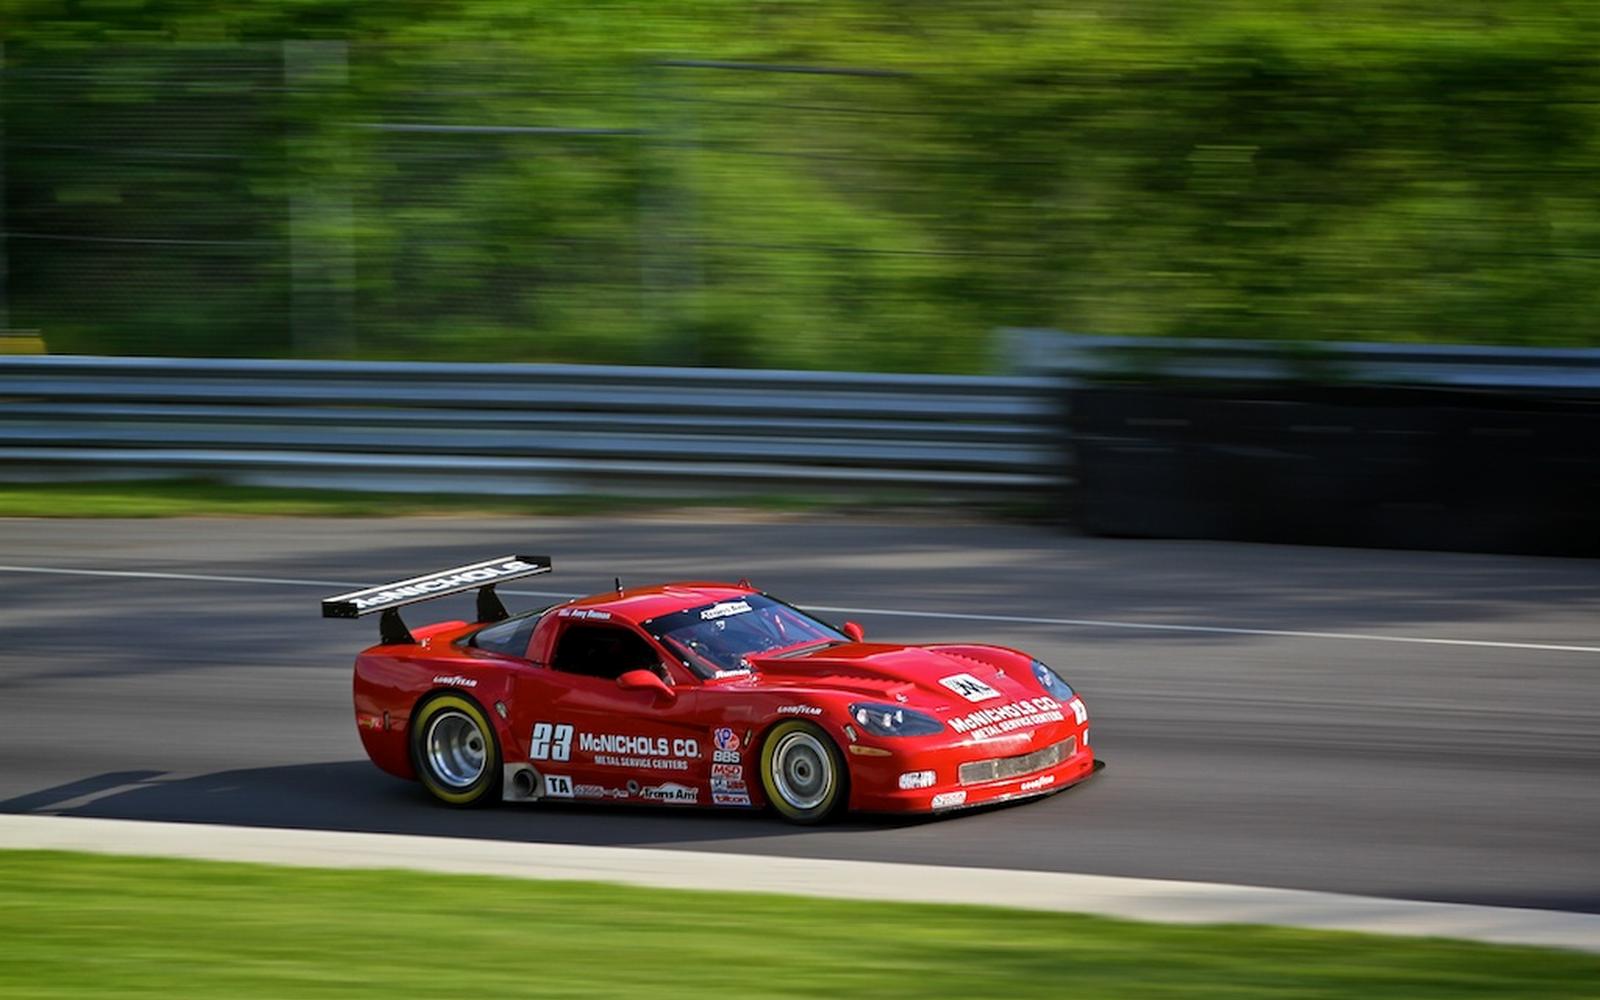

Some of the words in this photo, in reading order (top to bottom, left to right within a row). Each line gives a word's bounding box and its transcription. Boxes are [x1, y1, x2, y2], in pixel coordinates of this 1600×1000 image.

[948, 700, 1038, 733] McNICHOLS
[1031, 696, 1063, 711] CO.
[970, 724, 1002, 740] METAL
[998, 715, 1036, 732] SERVICE
[1031, 711, 1065, 724] CENTERS
[530, 723, 574, 761] 23
[579, 733, 669, 756] McNICHOLS
[673, 739, 702, 758] CO.
[594, 755, 620, 767] METAL
[620, 758, 652, 768] SERVICE
[652, 759, 688, 770] CENTERS
[713, 751, 740, 763] BBS
[549, 777, 570, 793] TA
